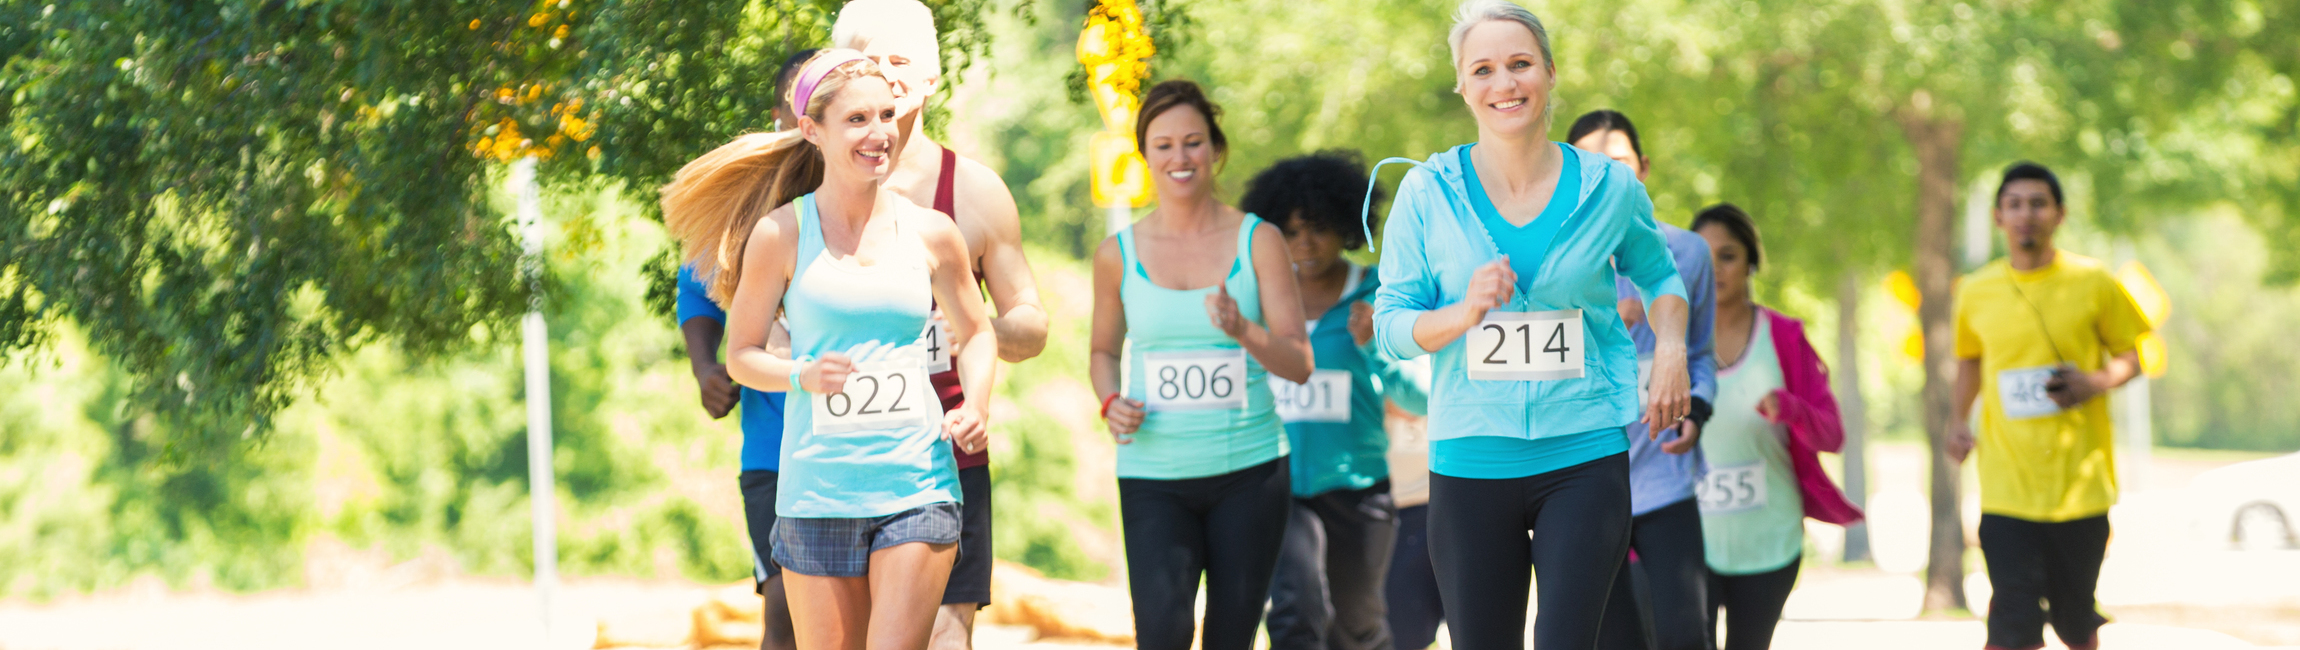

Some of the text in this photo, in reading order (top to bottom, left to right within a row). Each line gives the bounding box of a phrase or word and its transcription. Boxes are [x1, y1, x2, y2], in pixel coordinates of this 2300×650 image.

[1482, 322, 1570, 364] 214
[826, 373, 911, 418] 622
[1158, 363, 1233, 400] 806
